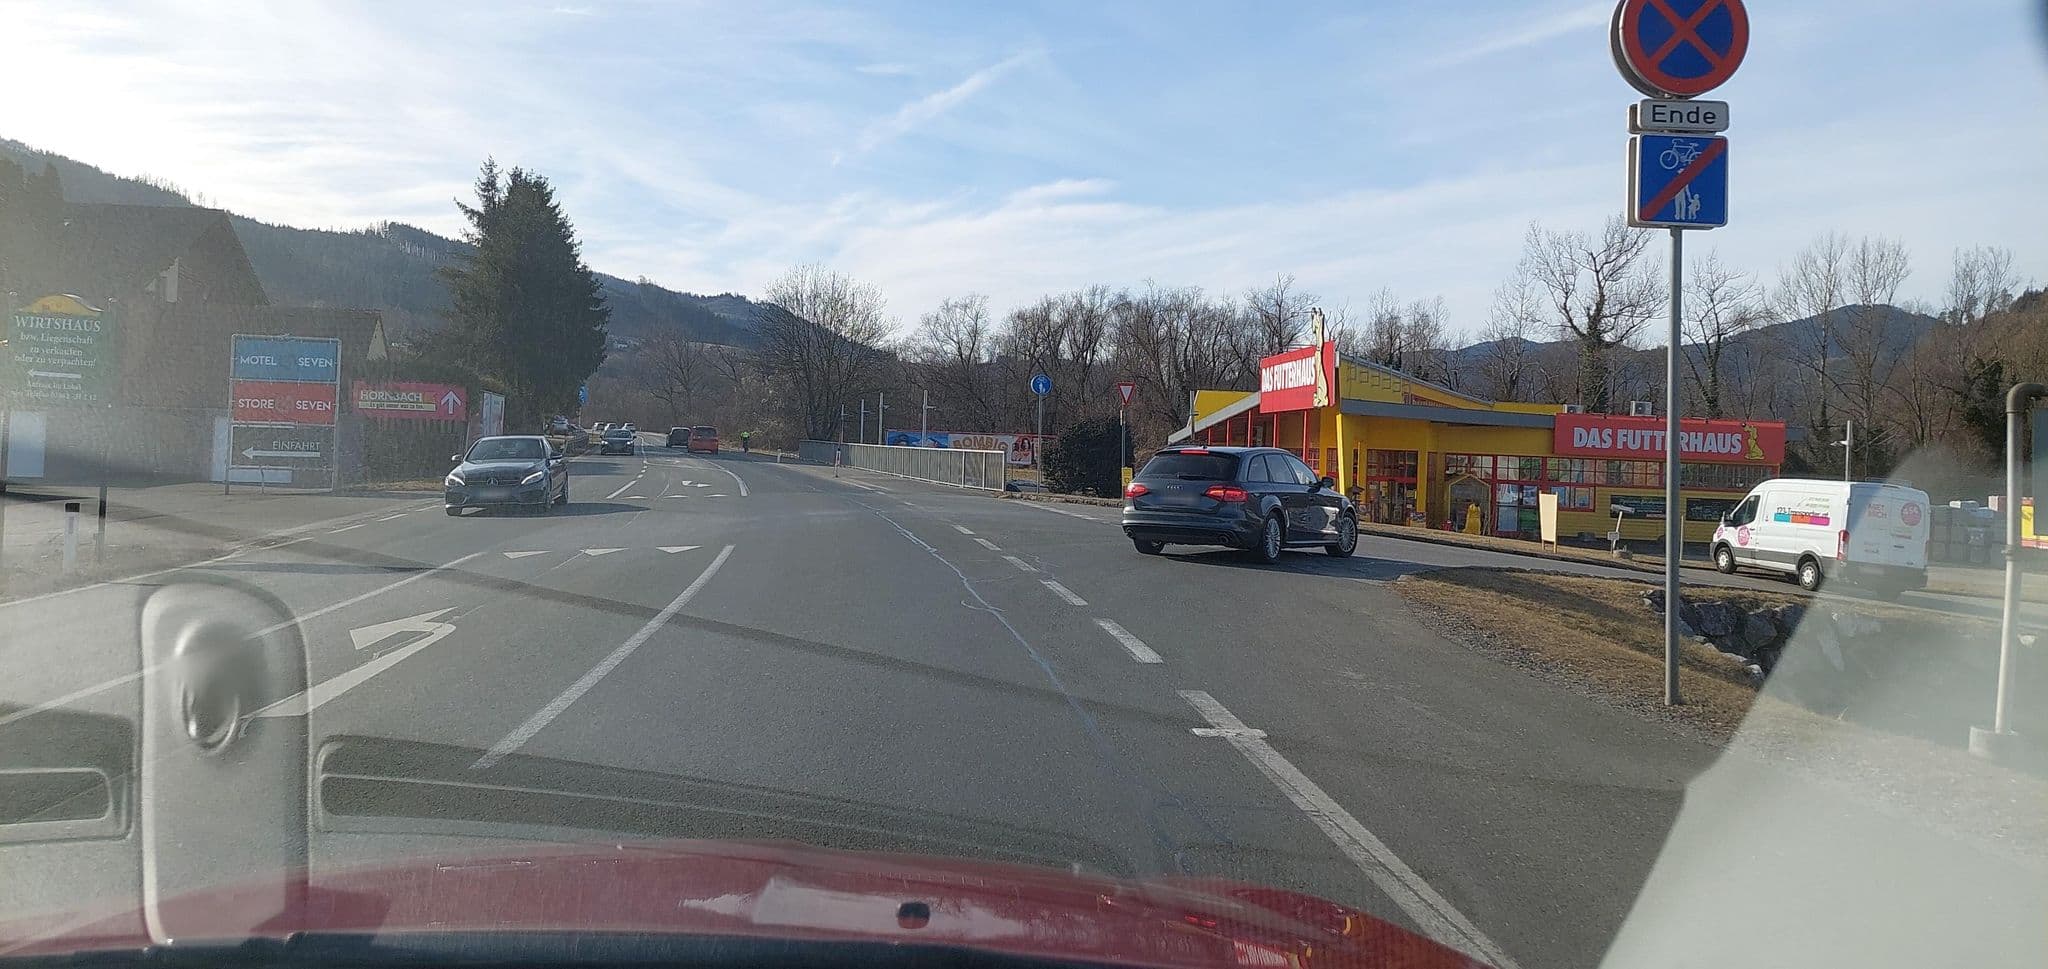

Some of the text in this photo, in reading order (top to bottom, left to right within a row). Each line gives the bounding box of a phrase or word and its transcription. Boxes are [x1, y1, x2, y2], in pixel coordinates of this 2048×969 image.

[1652, 105, 1716, 124] Ende
[15, 315, 101, 332] WIRTSHAUS
[41, 333, 93, 344] Liegenschaft
[42, 347, 83, 356] verkaufen
[240, 355, 333, 368] MOTEL SEVEN
[1262, 356, 1316, 393] DAS FUTTERHAUS
[360, 390, 422, 402] HORNBACH
[238, 398, 331, 412] STORE SEVEN
[272, 441, 320, 452] EINFAHRT
[1573, 427, 1742, 455] DAS FUTTRHAUS
